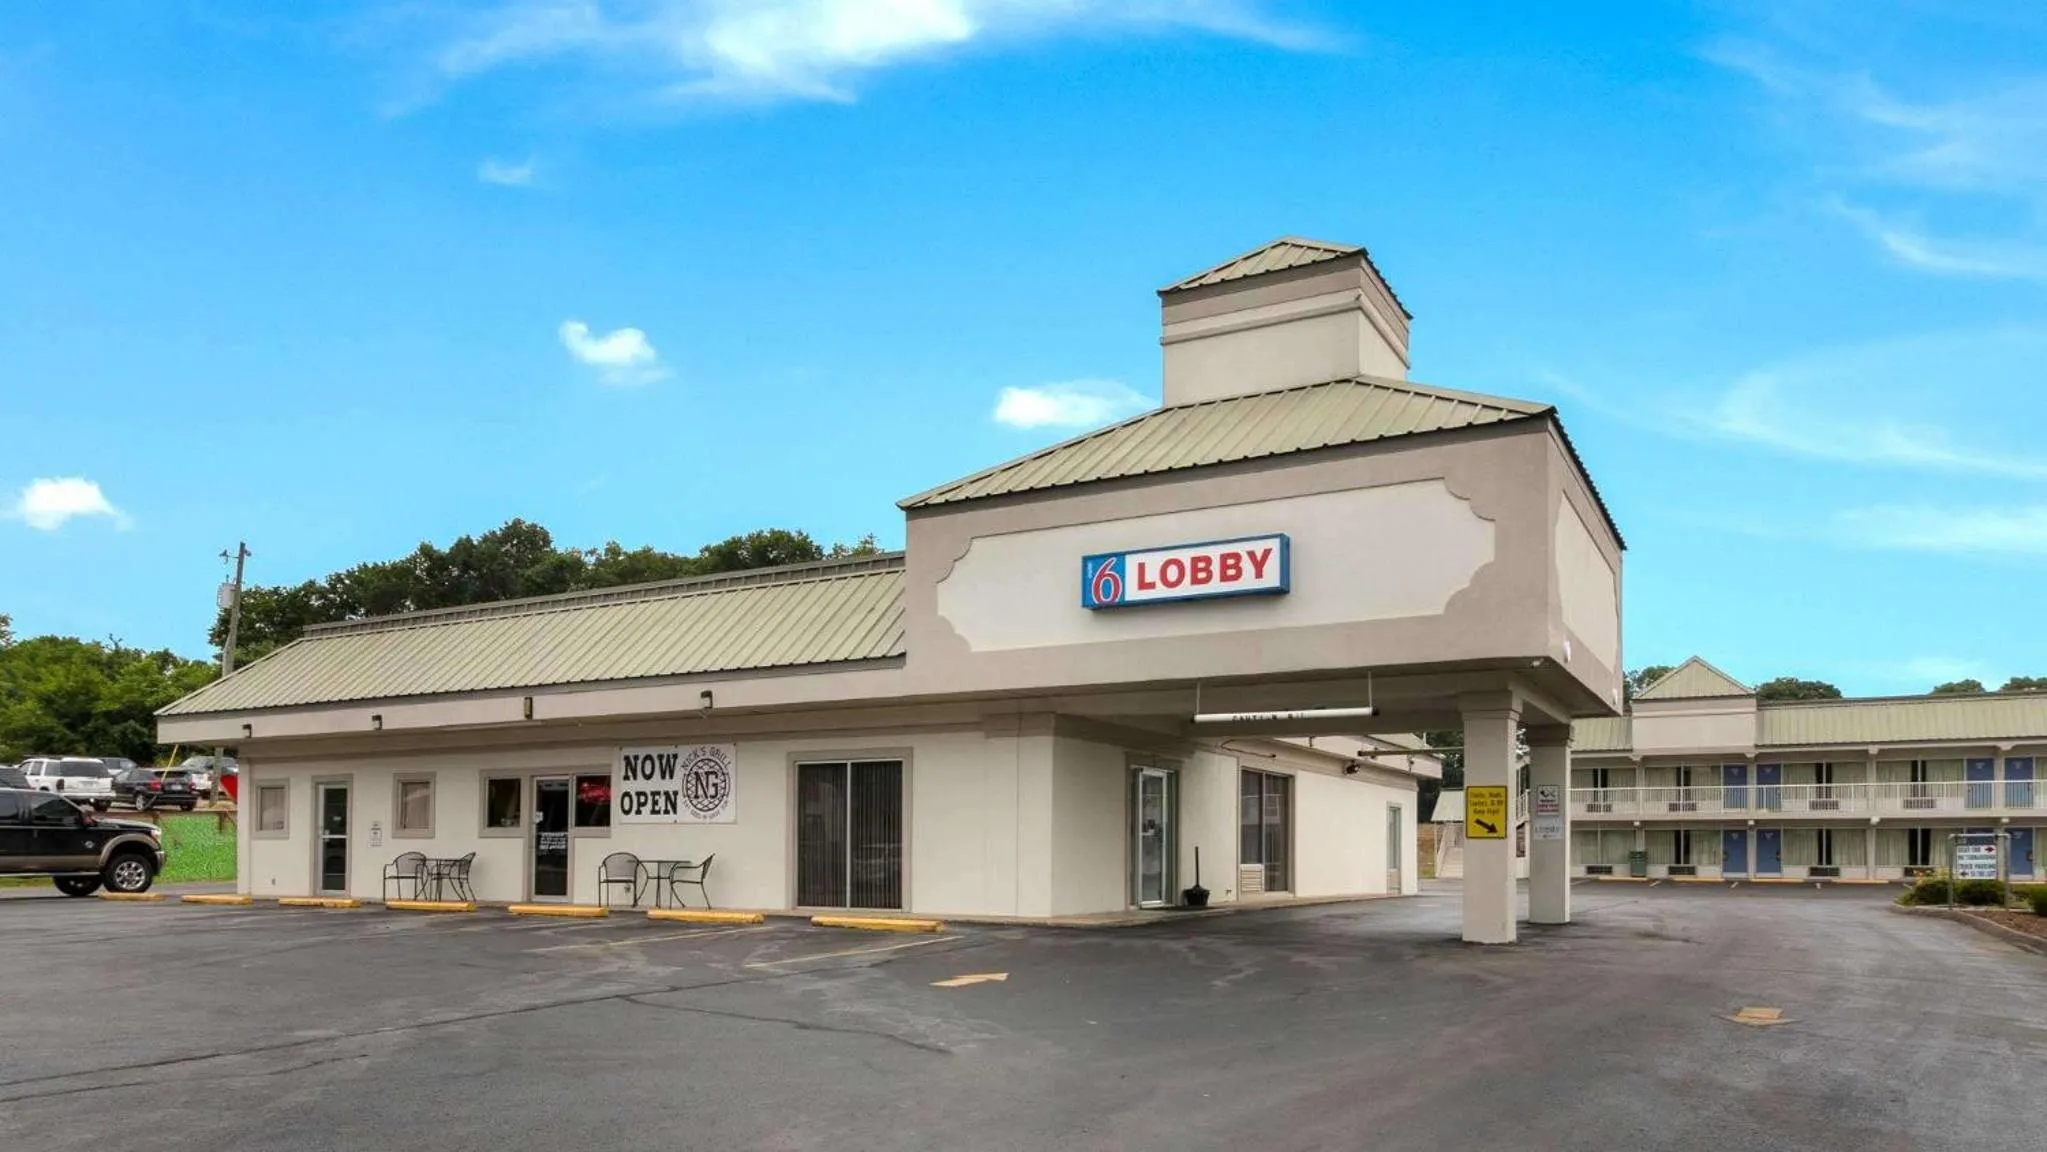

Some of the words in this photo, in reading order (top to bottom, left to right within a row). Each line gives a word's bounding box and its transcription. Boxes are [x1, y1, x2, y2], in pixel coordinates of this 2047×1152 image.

[1092, 556, 1123, 606] 6
[1137, 548, 1273, 592] LOBBY
[623, 752, 679, 781] NOW
[693, 770, 719, 799] NG
[620, 790, 679, 816] OPEN
